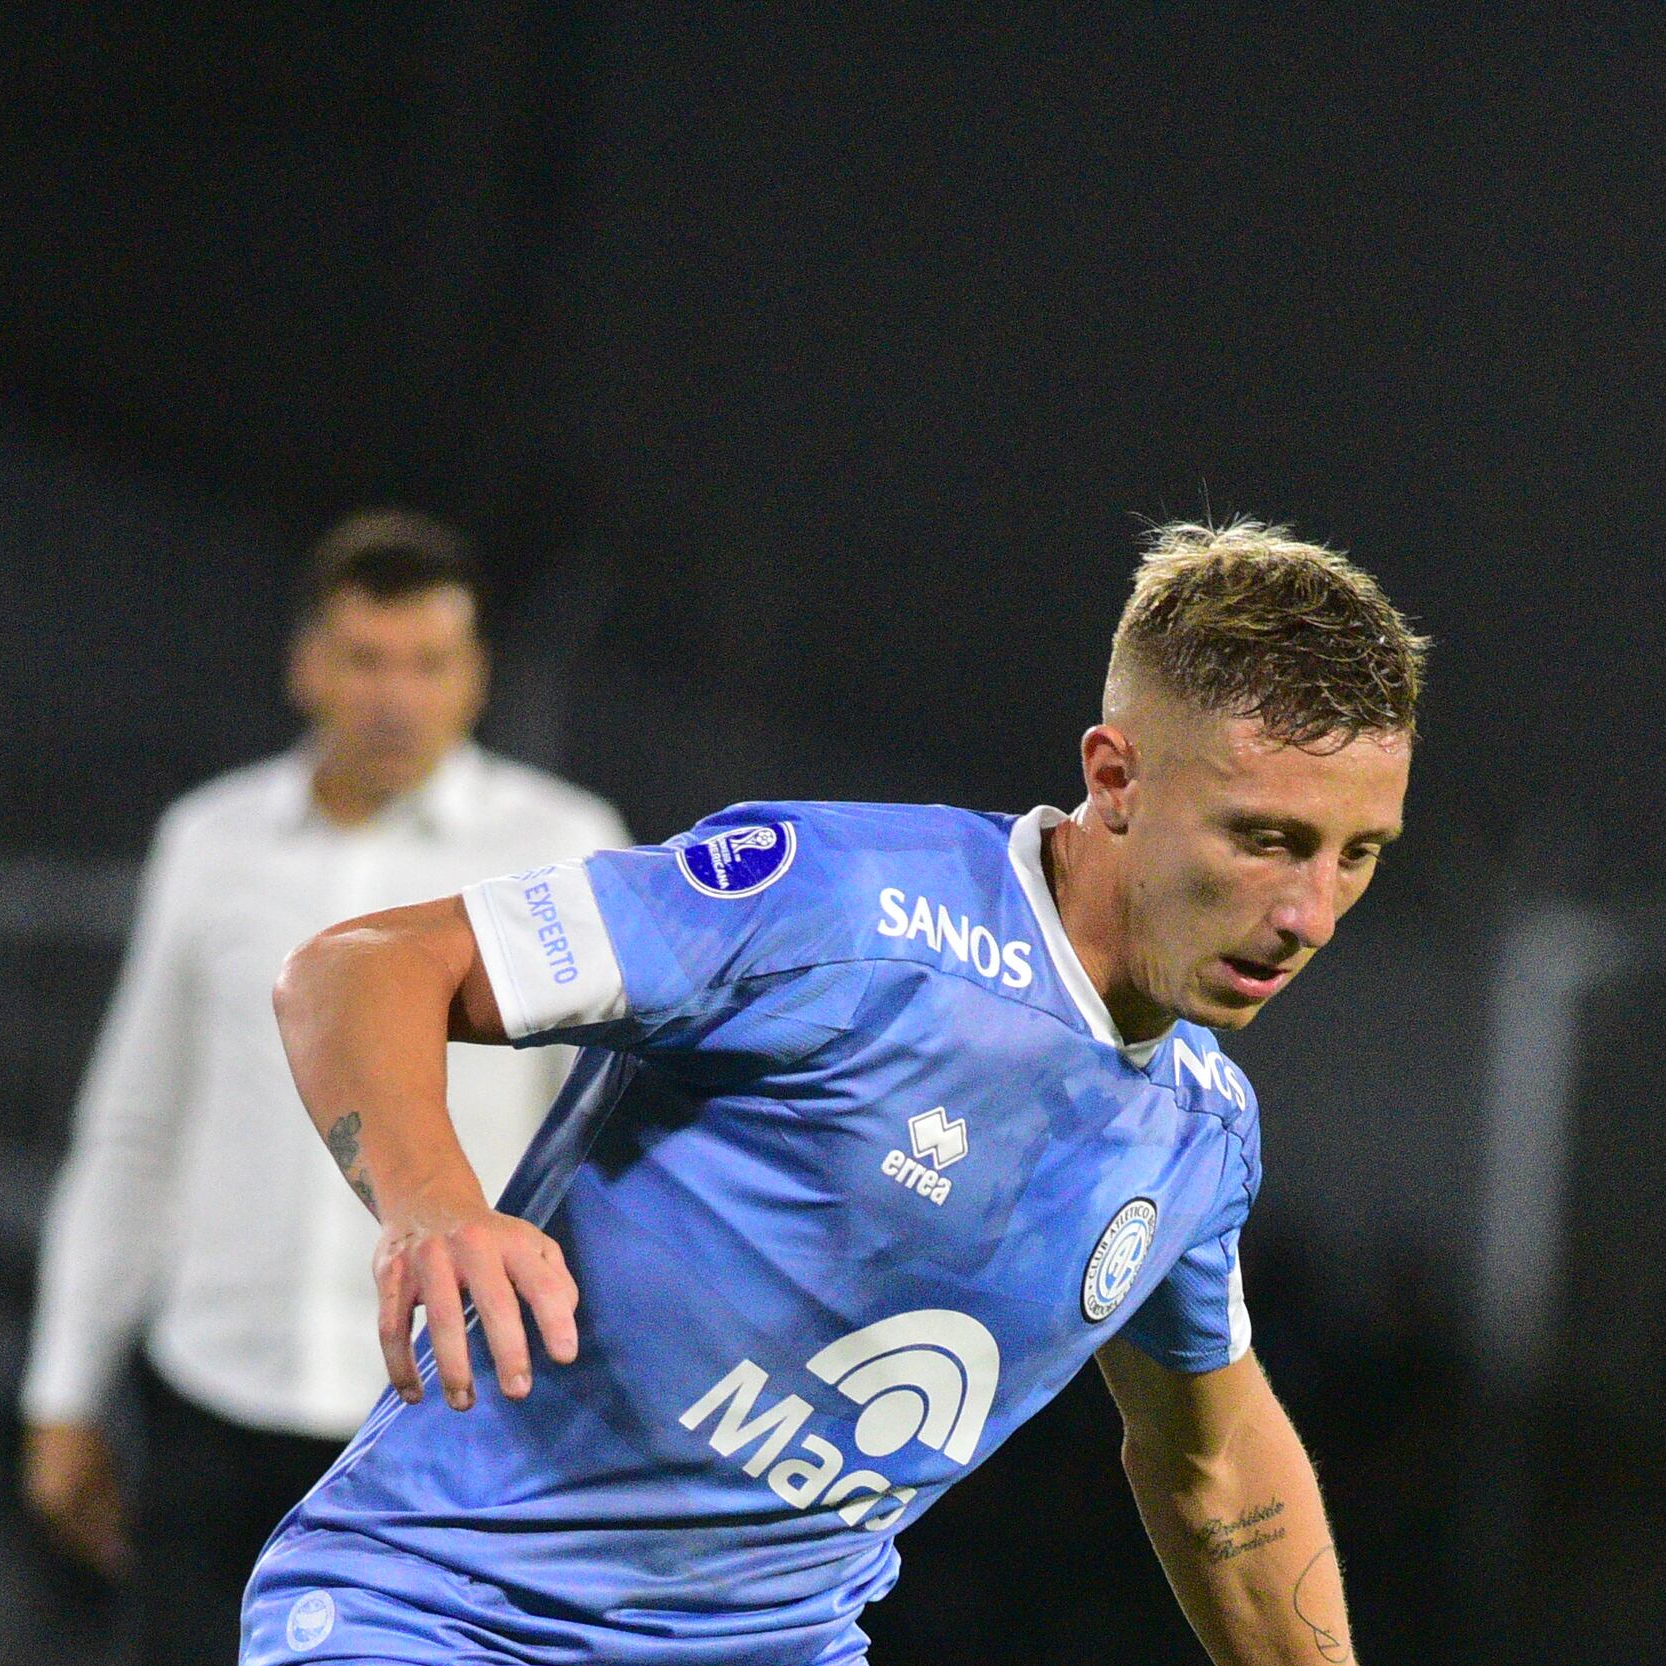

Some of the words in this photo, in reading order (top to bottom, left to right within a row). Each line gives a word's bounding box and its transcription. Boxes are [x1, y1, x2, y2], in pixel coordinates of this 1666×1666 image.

[524, 881, 579, 985] EXPERTO
[876, 887, 1033, 989] SANOS
[881, 1148, 953, 1207] errea
